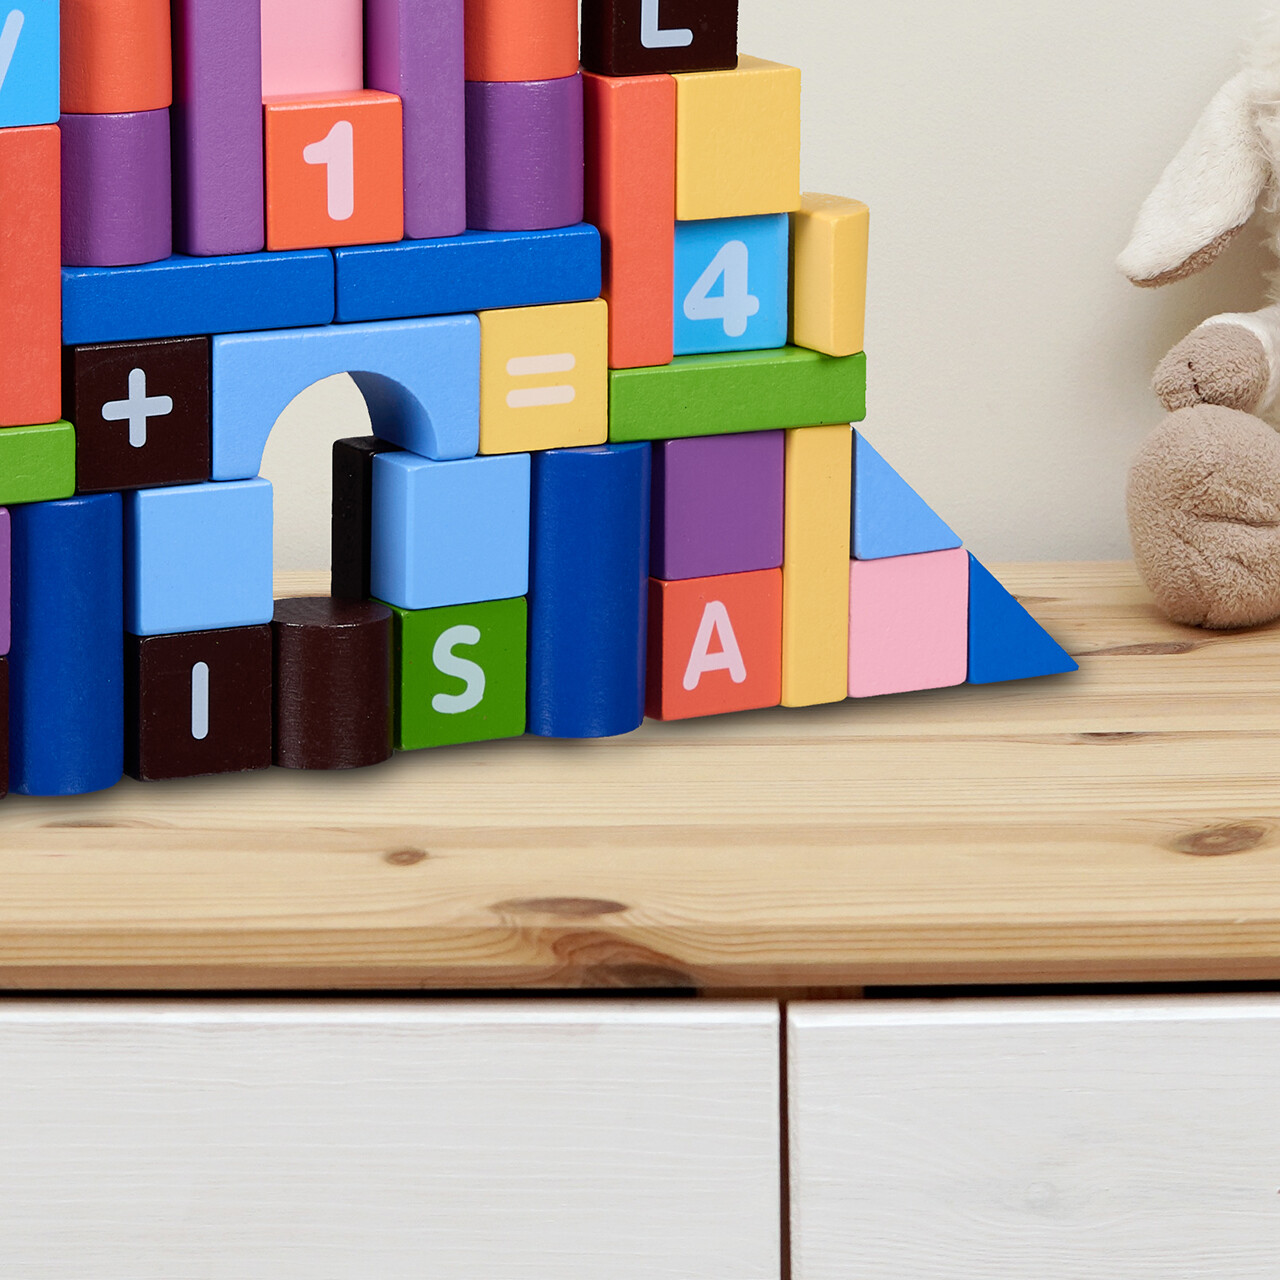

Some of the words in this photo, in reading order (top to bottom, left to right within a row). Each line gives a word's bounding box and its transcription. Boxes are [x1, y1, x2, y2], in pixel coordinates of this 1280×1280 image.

[303, 121, 354, 220] 1
[684, 240, 759, 337] 4
[432, 625, 485, 714] S
[683, 601, 746, 690] A
[192, 662, 209, 739] I
